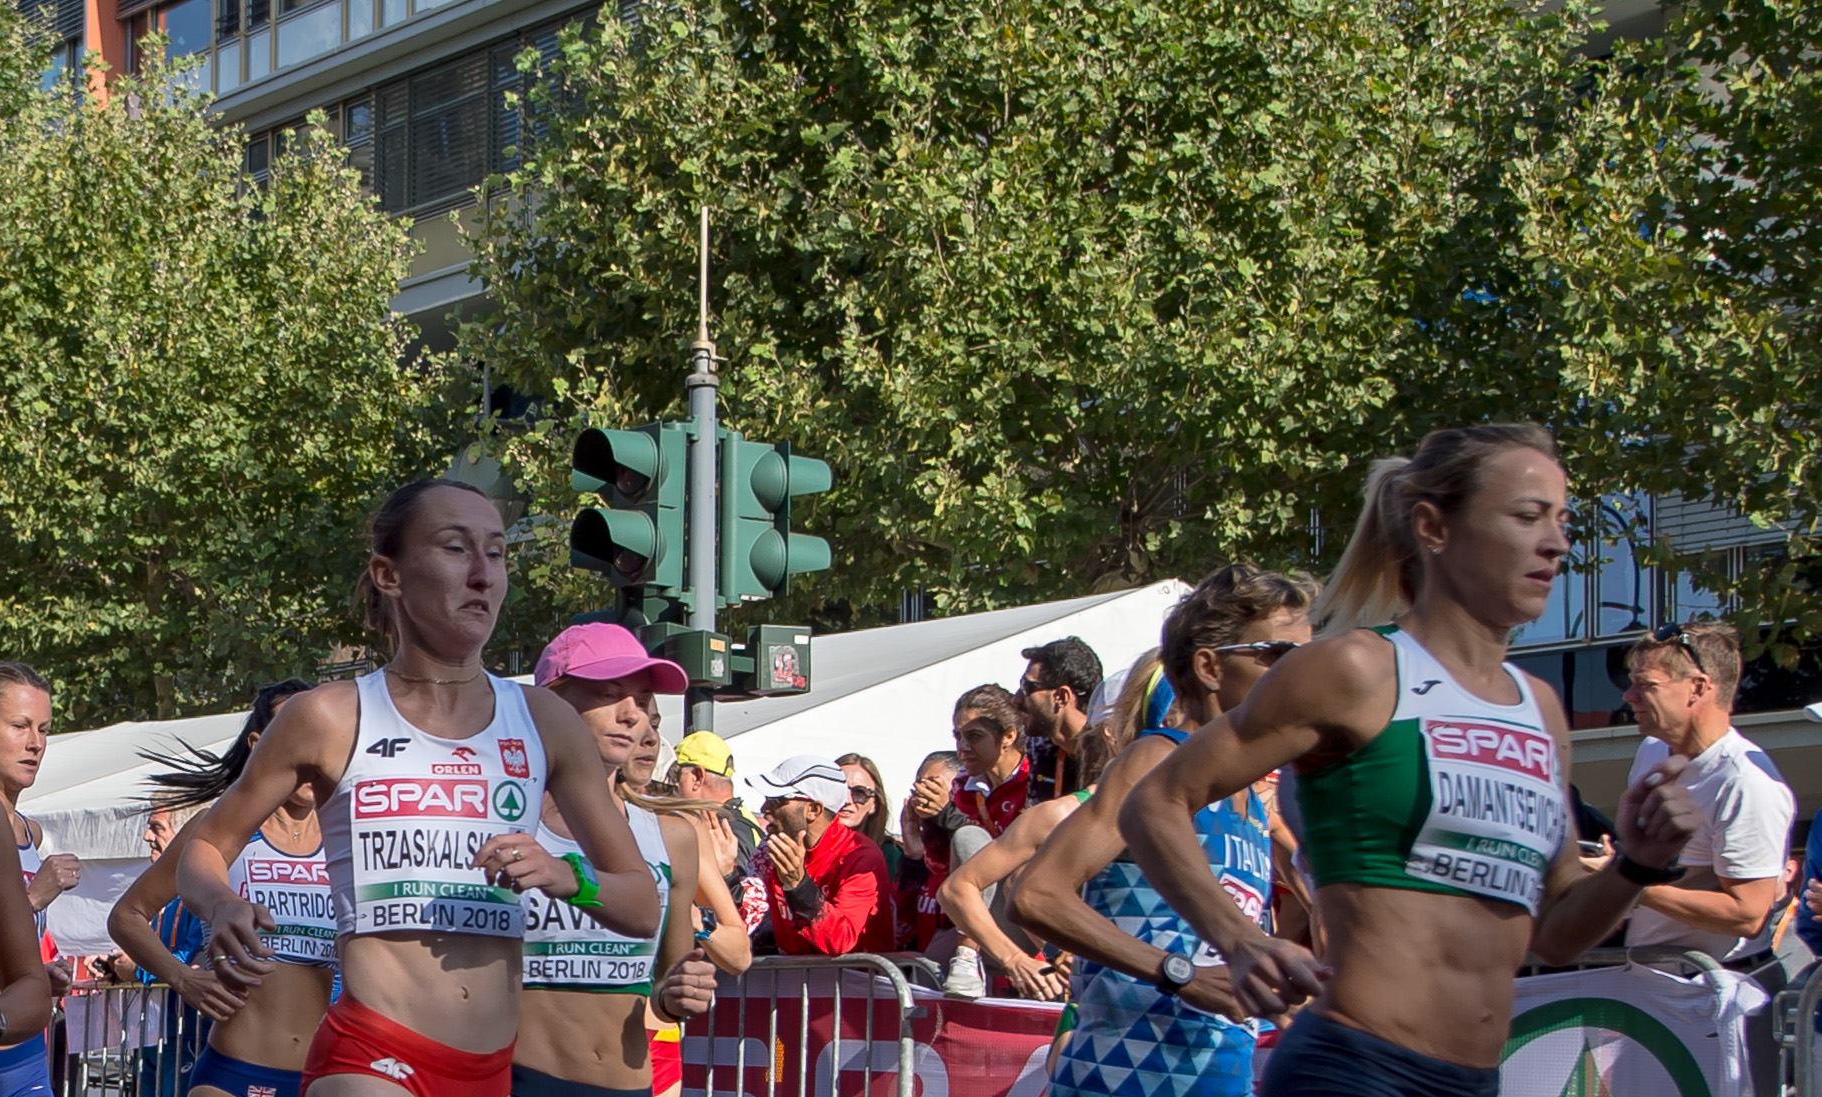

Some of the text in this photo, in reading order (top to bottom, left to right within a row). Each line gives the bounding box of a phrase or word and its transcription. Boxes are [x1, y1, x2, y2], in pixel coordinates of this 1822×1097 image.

[366, 737, 411, 758] 4F
[1432, 727, 1549, 775] SPAR
[434, 765, 479, 775] ORLEN
[358, 782, 486, 814] SPAR
[1438, 771, 1559, 843] DAMANTSEVICH
[1477, 840, 1515, 857] RUN
[1431, 853, 1527, 896] BERLIN
[394, 884, 398, 896] I
[402, 883, 435, 896] RUN
[373, 903, 510, 931] BERLIN 2018
[283, 926, 305, 934] RUN
[260, 936, 316, 955] BERLIN
[556, 943, 581, 954] RUN
[529, 960, 646, 979] BERLIN 2018
